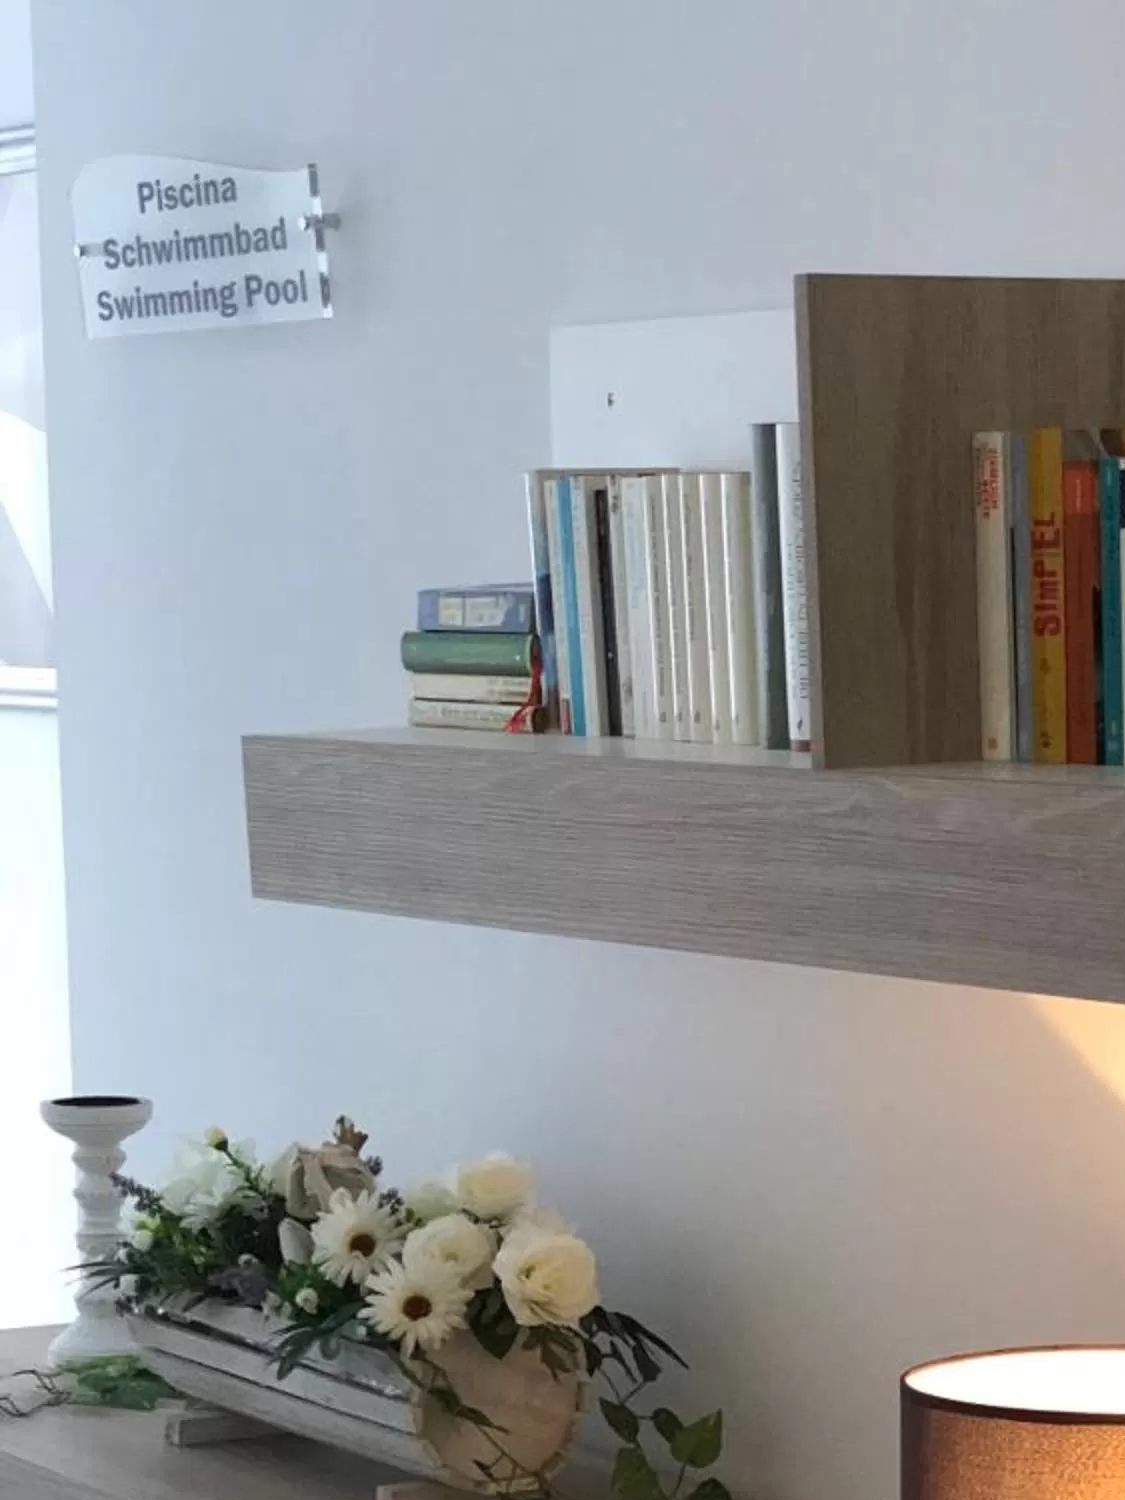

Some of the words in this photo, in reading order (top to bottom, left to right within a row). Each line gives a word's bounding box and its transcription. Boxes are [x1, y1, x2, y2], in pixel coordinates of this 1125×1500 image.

[136, 173, 238, 214] Piscina
[102, 216, 288, 270] Schwimmbad
[96, 279, 239, 322] Swimming
[243, 269, 309, 308] Pool
